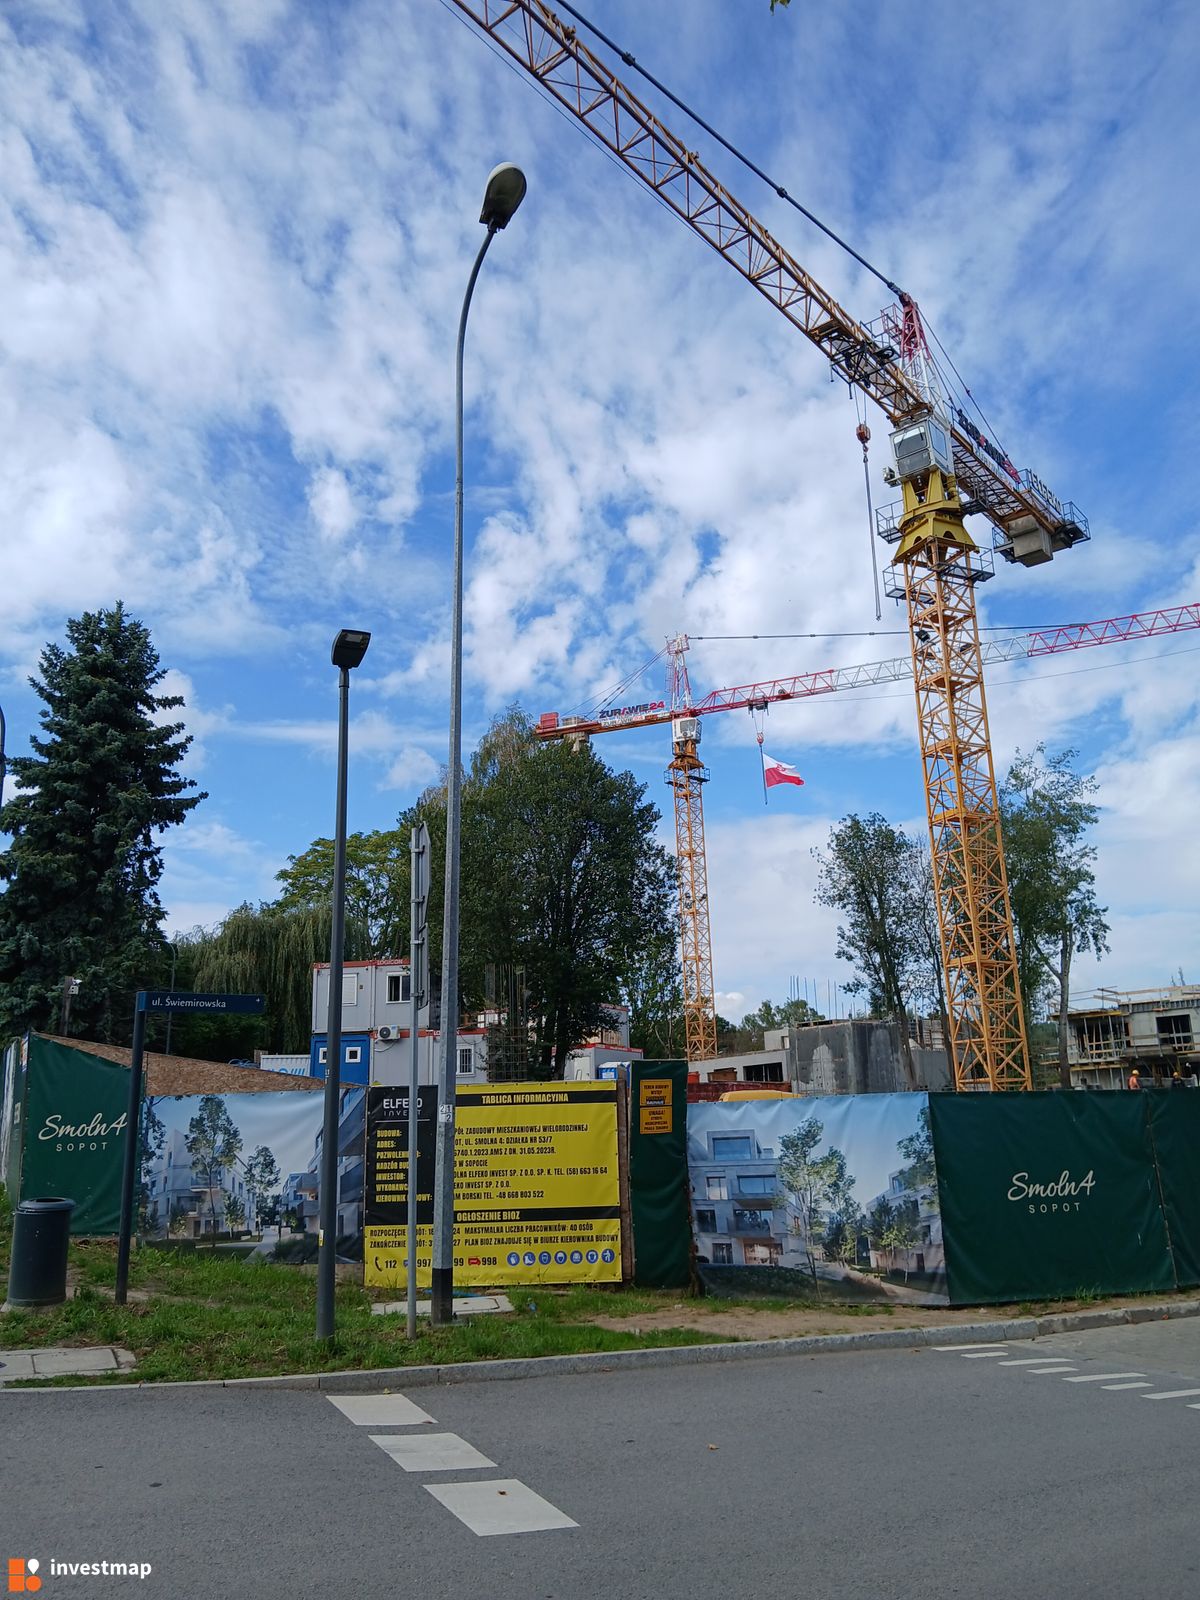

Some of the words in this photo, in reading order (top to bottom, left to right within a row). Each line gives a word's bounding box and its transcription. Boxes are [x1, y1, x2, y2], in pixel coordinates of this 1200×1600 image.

[152, 998, 162, 1006] ul.
[165, 996, 226, 1008] Świemirowska
[383, 1098, 422, 1108] ELFEO
[482, 1095, 512, 1104] TABLICA
[514, 1093, 569, 1103] INFORMACYJNA
[56, 1142, 108, 1152] SOPOT
[1029, 1202, 1080, 1214] SOPOT
[457, 1212, 501, 1221] OGŁOSZENIE
[503, 1211, 520, 1220] BIOZ
[370, 1228, 406, 1238] ROZPOCZĘCIE
[525, 1224, 568, 1232] PRACOWNIKÓW:
[579, 1222, 593, 1230] OSÓB
[370, 1239, 406, 1248] ZAKOŃCZENIE
[385, 1260, 397, 1268] 112
[417, 1259, 431, 1267] 997
[454, 1258, 464, 1266] 99
[482, 1257, 497, 1265] 998
